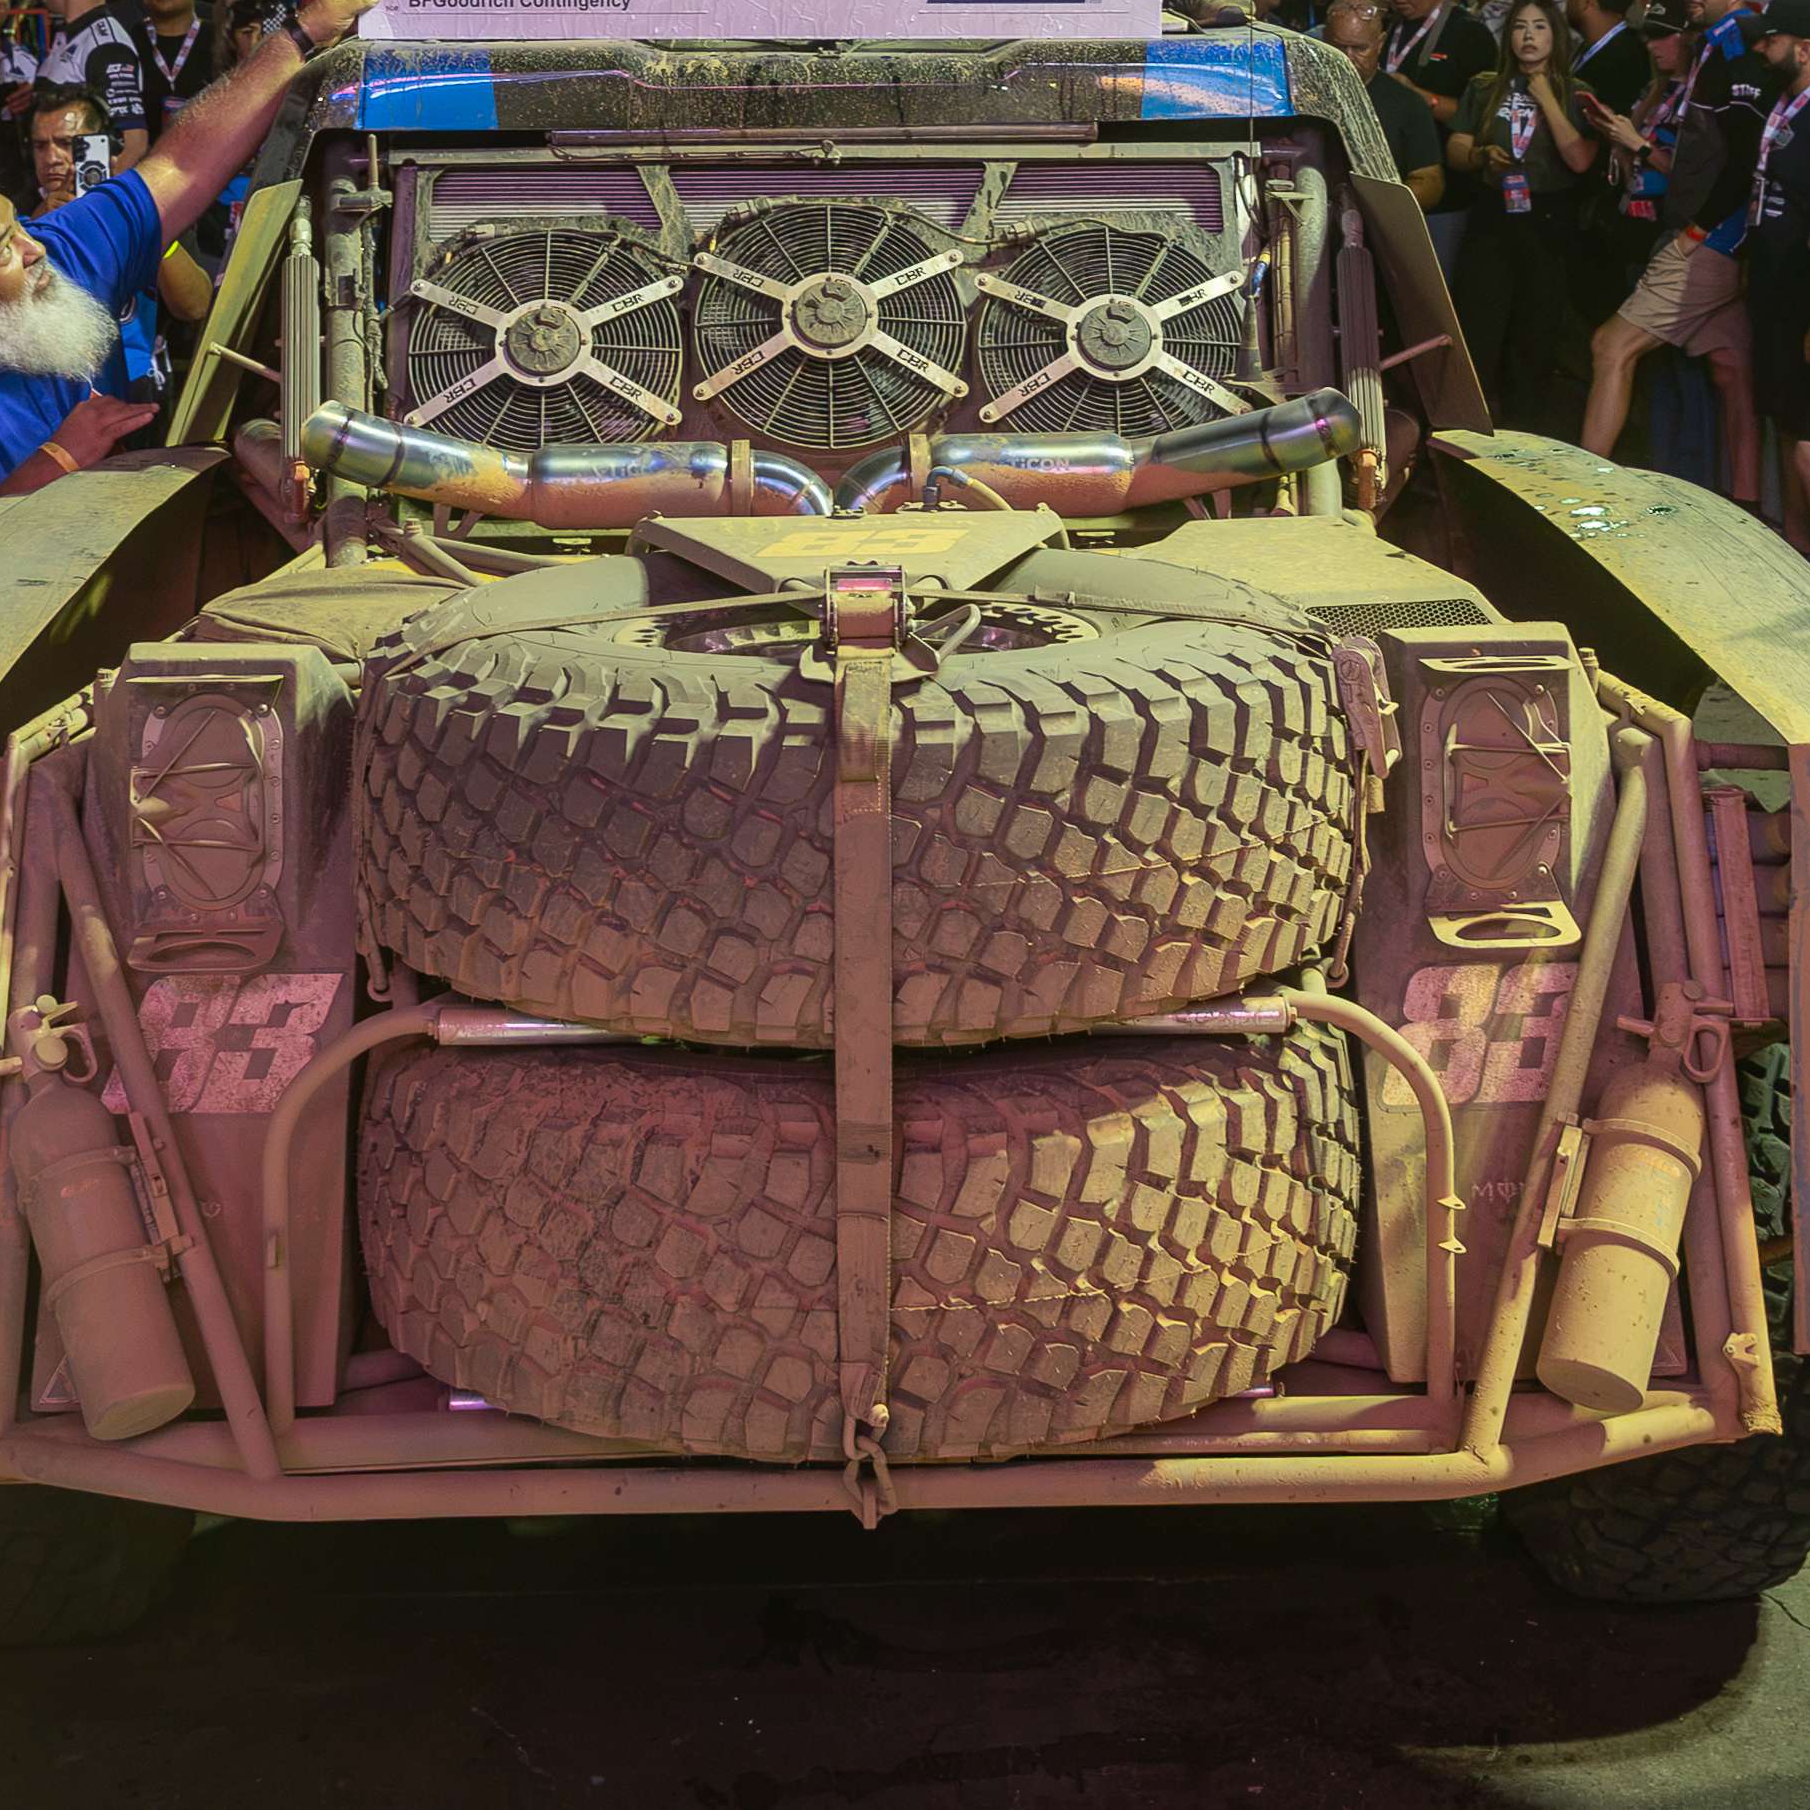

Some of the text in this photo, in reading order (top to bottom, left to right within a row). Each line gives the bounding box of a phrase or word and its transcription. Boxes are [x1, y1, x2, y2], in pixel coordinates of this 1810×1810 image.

[895, 264, 928, 286] CBR
[611, 292, 644, 312] CBR
[732, 349, 767, 374] CBR
[895, 348, 930, 374] CBR
[444, 378, 478, 402] CBR
[610, 375, 643, 399] CBR
[1017, 372, 1051, 398] CBR
[1182, 369, 1216, 395] CBR
[753, 528, 970, 558] 83
[1381, 961, 1579, 1106] 83
